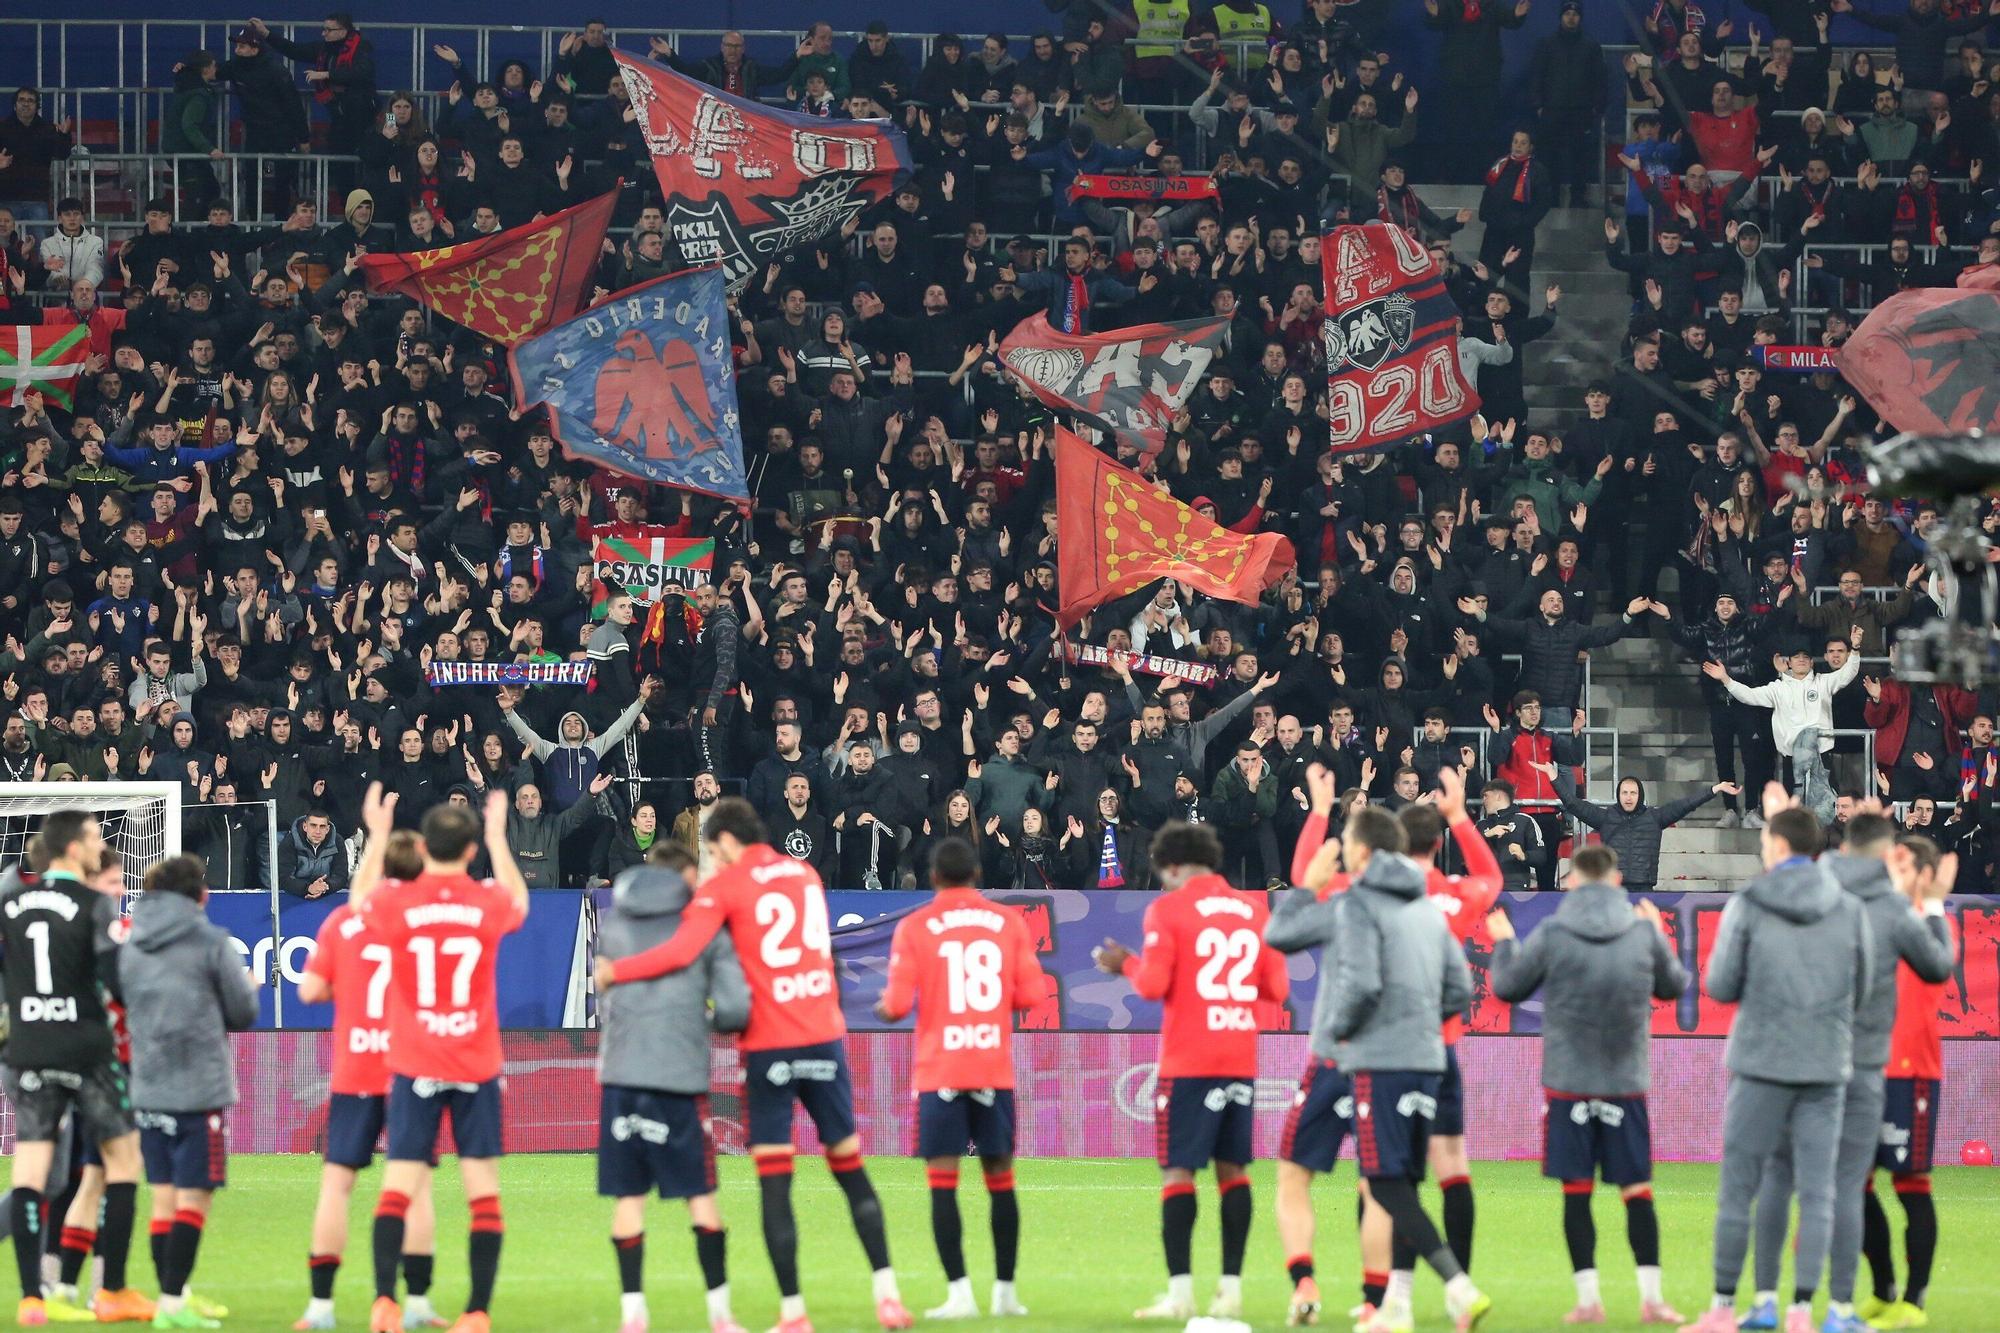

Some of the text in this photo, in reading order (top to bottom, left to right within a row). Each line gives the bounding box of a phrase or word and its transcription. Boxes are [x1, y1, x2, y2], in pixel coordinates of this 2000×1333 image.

[1108, 179, 1189, 192] OSASUNA
[432, 662, 593, 685] INDAR GORRI
[791, 837, 805, 853] G
[755, 884, 832, 969] 24
[25, 921, 53, 995] 1
[407, 936, 483, 1008] 17
[1195, 927, 1260, 1002] 22
[360, 943, 393, 1020] 7
[773, 968, 832, 1004] DIGI
[938, 939, 1003, 1014] 18
[20, 996, 78, 1022] DIGI
[1207, 1006, 1257, 1032] DIGI
[943, 1023, 1001, 1050] DIGI
